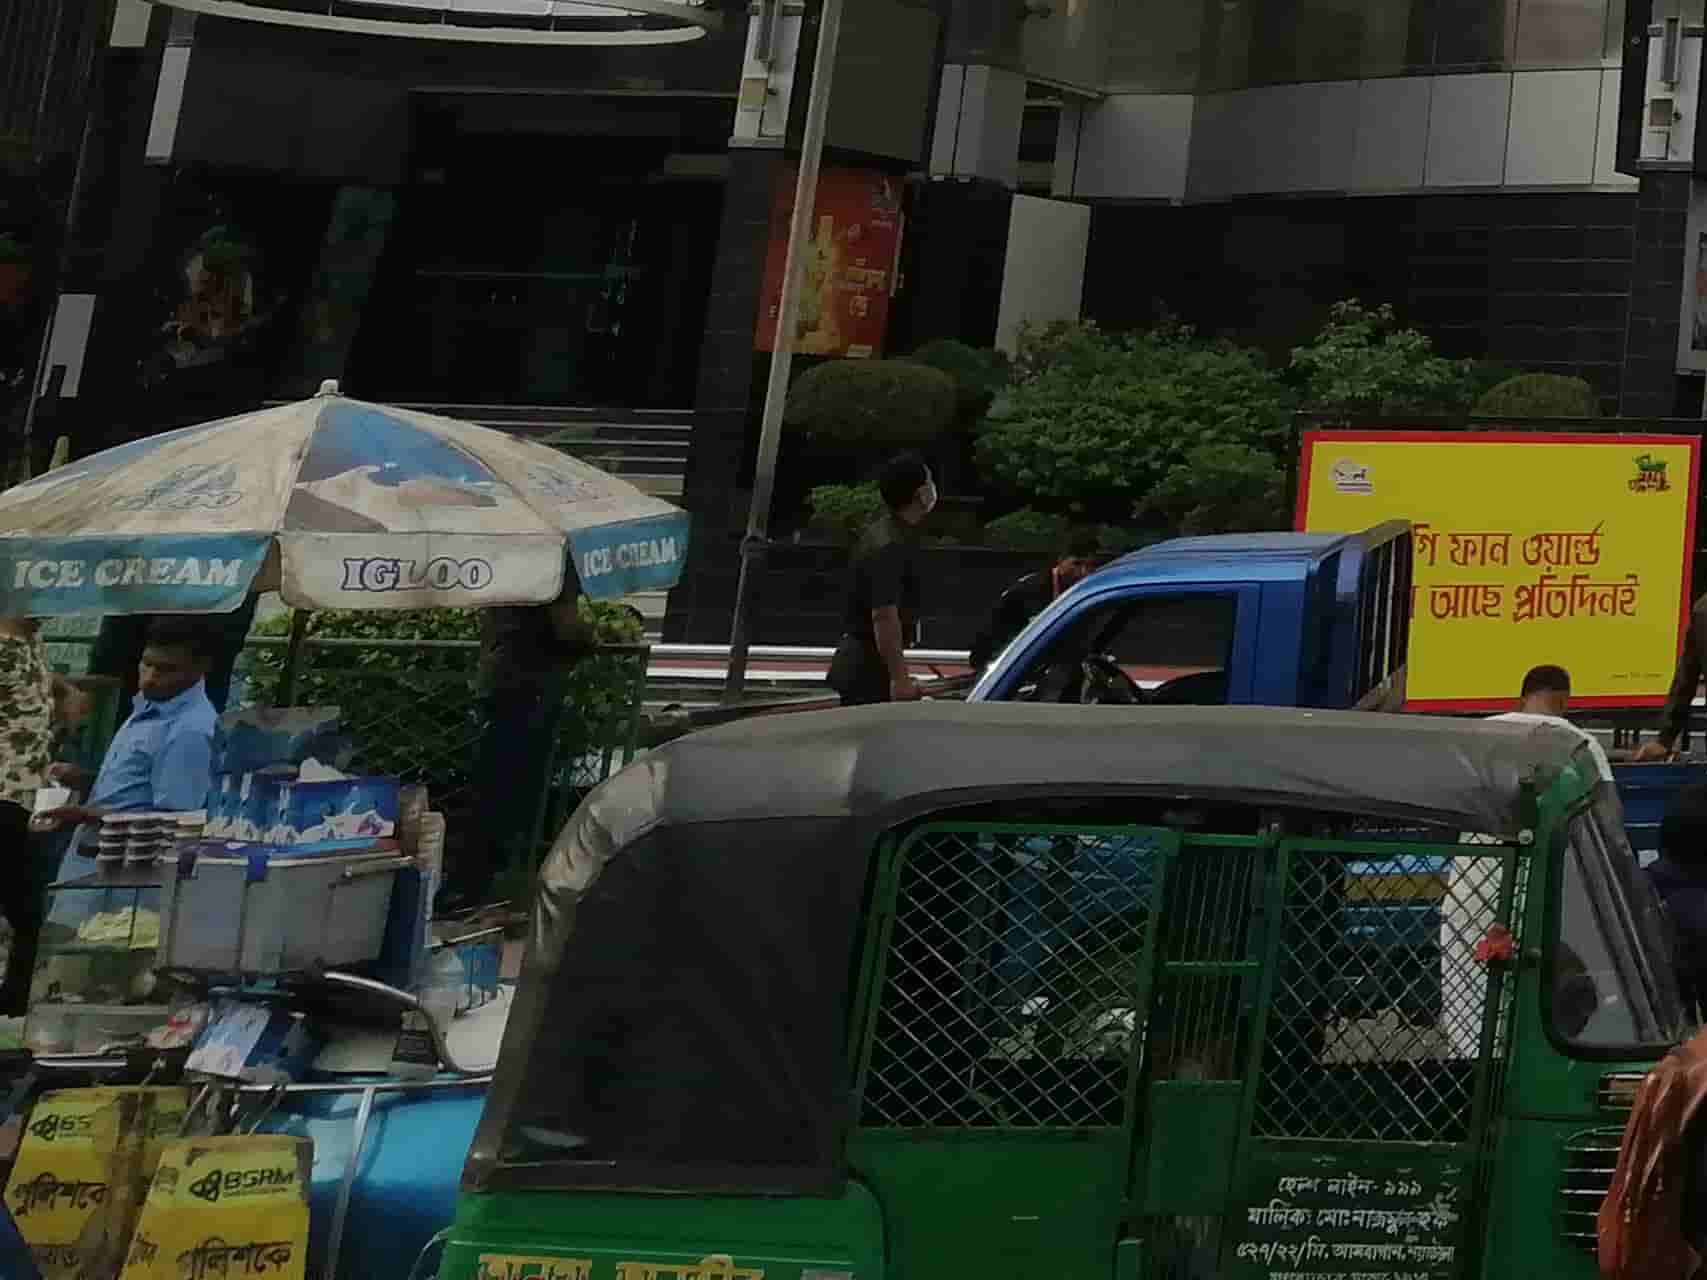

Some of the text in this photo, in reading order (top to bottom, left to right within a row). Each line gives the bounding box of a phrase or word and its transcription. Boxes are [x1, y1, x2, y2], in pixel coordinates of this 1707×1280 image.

[583, 552, 612, 579] ICE
[1448, 531, 1513, 568] ফান
[13, 555, 245, 591] ICE CREAM
[341, 556, 493, 591] IGLOO
[1429, 584, 1505, 620] আছে
[1511, 572, 1641, 624] প্রতিদিনই
[223, 1168, 294, 1190] BSRM
